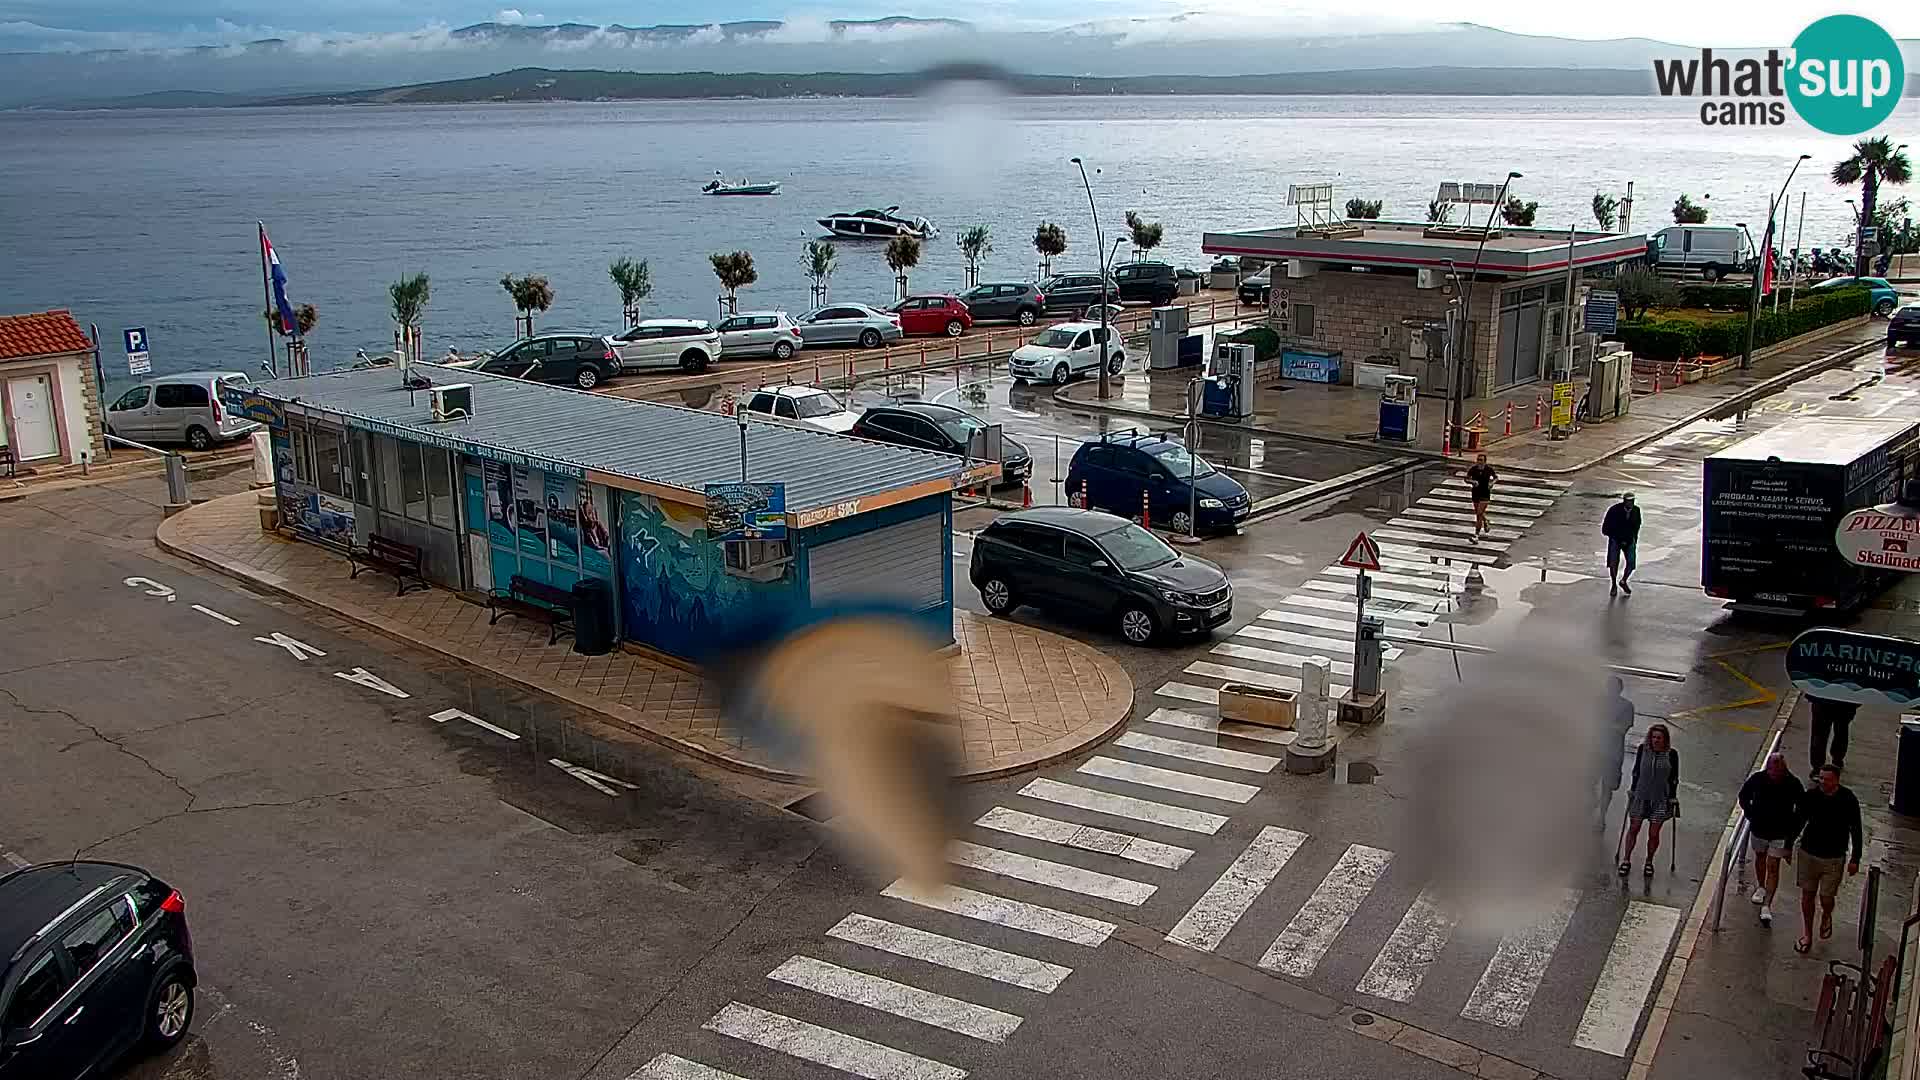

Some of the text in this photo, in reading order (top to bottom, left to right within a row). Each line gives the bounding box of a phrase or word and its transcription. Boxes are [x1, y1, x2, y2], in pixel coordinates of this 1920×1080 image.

[128, 331, 142, 350] P
[477, 445, 492, 458] BUS
[494, 448, 526, 465] STATION
[527, 456, 553, 471] TICKET
[554, 462, 582, 477] OFFICE
[1880, 530, 1914, 541] GRILL
[1826, 662, 1895, 680] caffe bar
